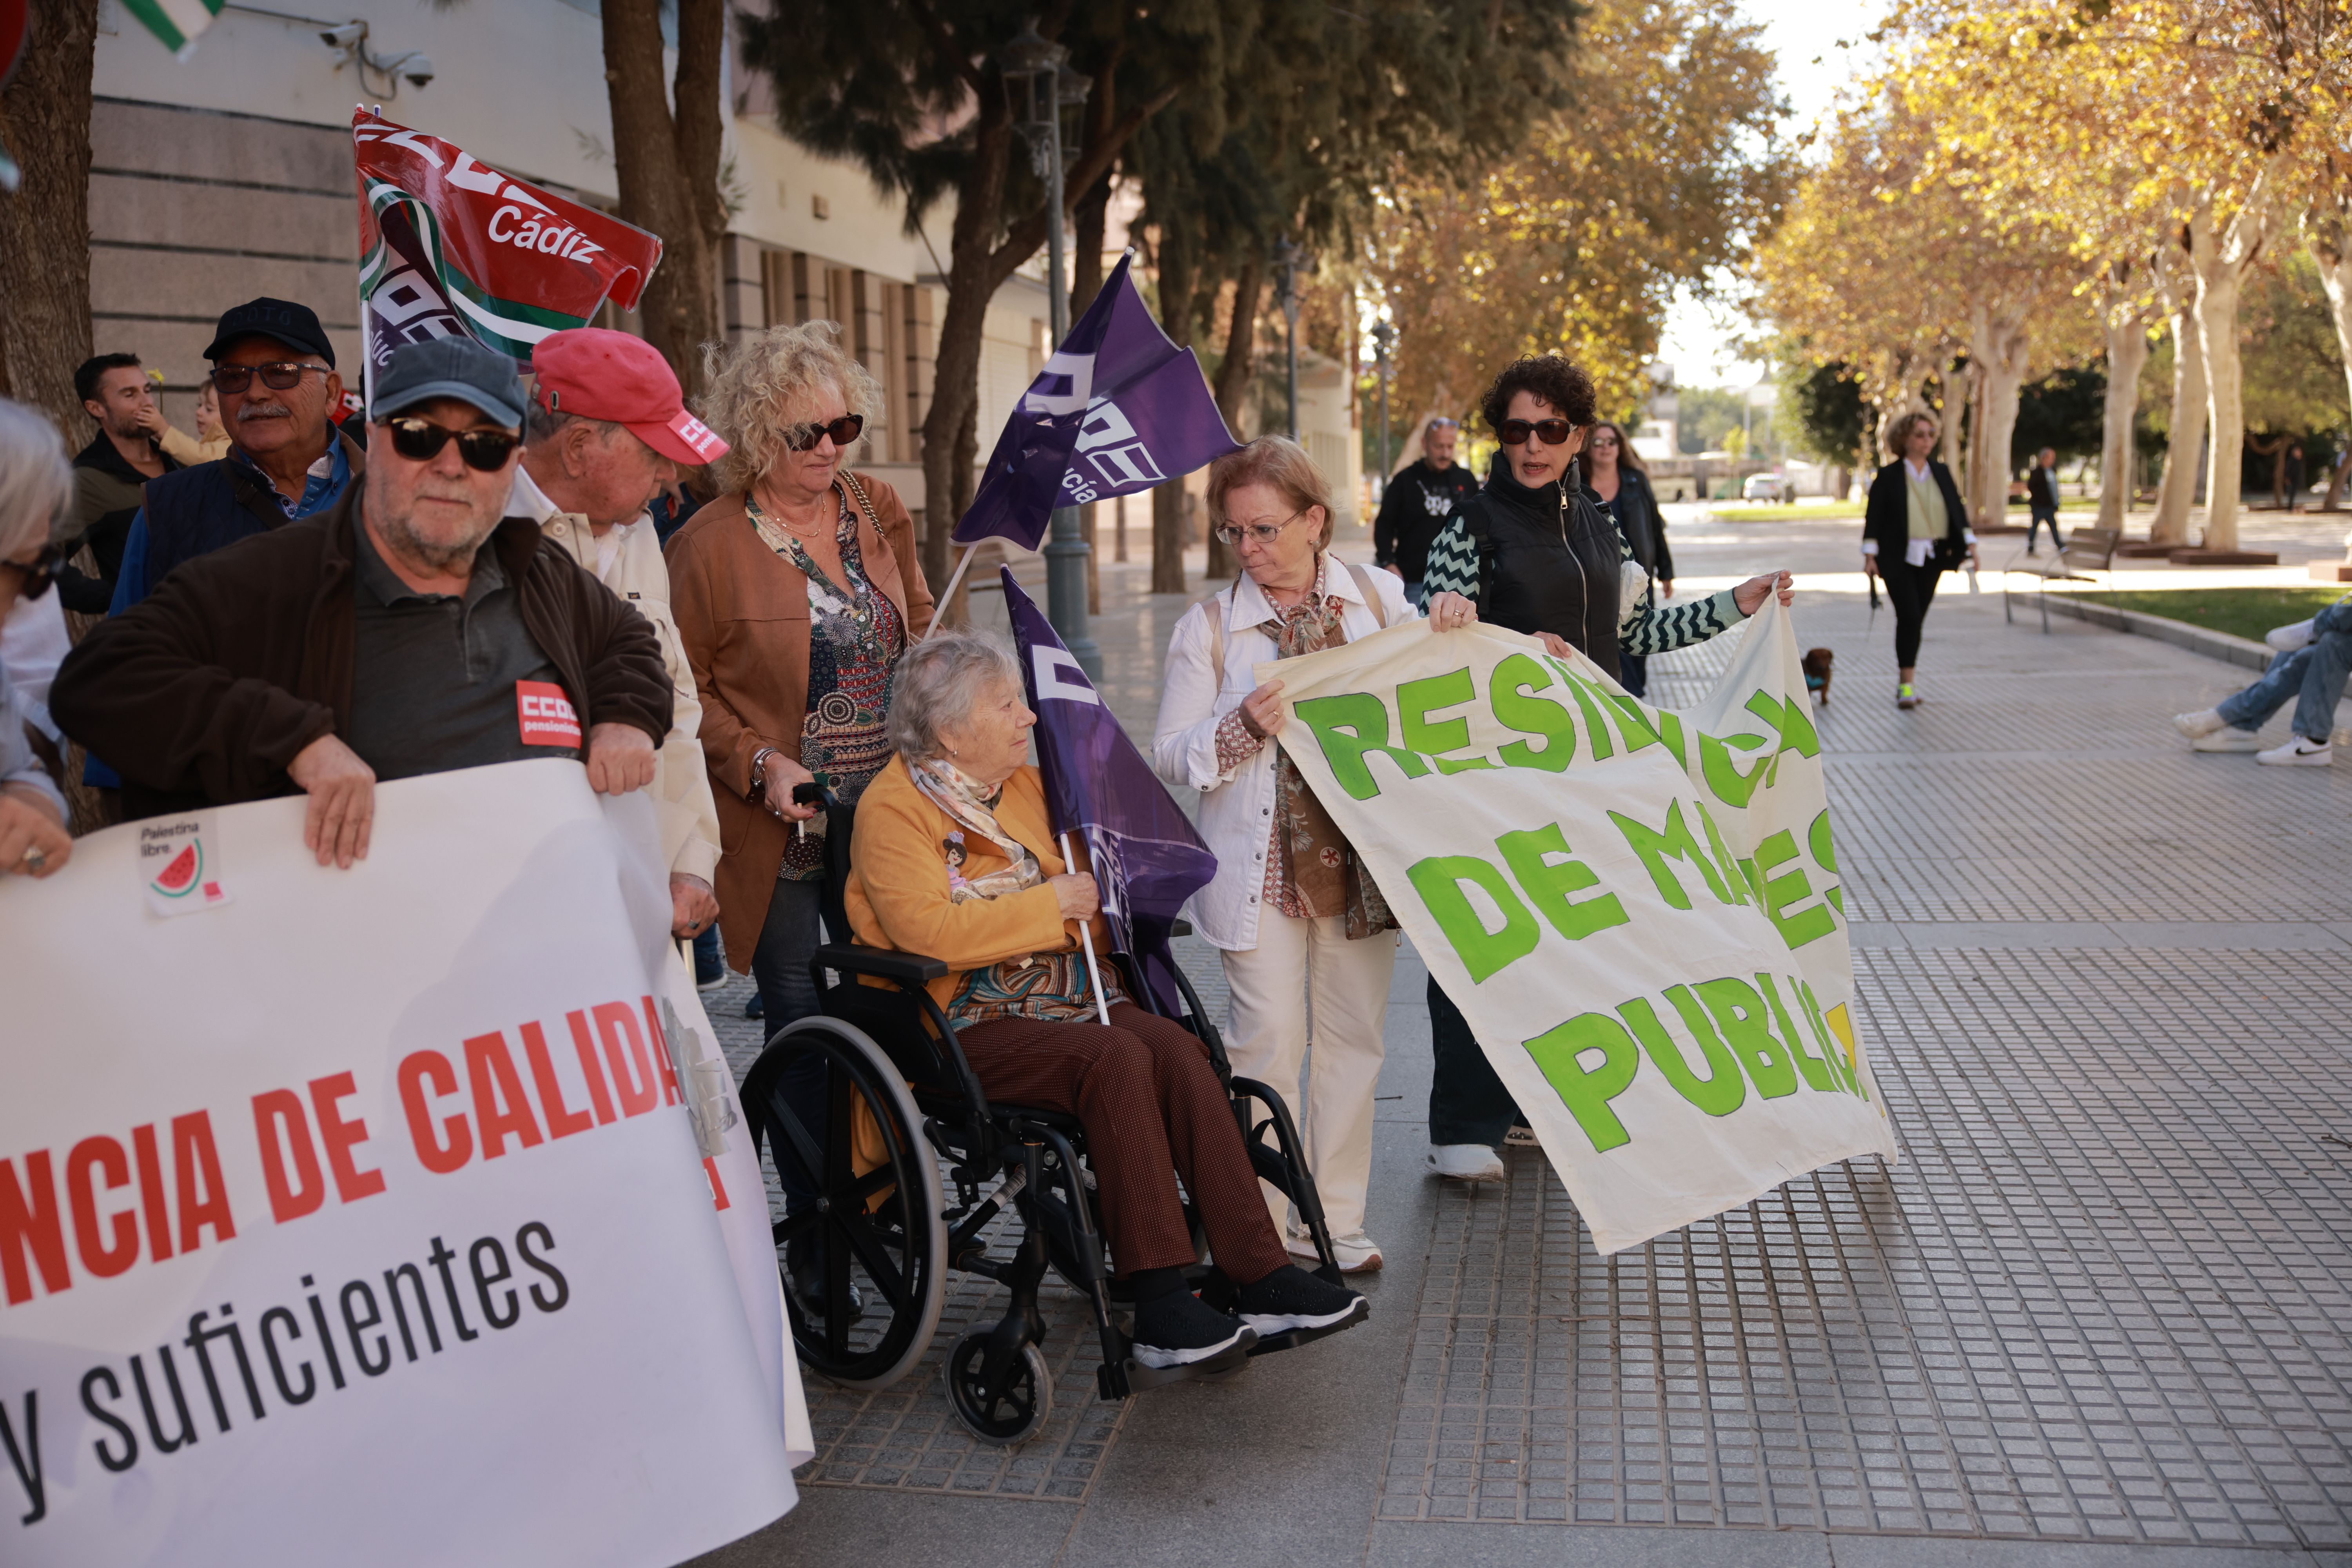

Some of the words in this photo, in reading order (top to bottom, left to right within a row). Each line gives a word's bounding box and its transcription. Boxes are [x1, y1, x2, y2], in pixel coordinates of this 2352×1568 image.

[488, 205, 606, 264] Cádiz
[141, 823, 199, 840] Palestina
[1406, 822, 1630, 985] DE
[0, 1109, 237, 1307] NCIA
[250, 1070, 387, 1225] DE
[0, 1388, 47, 1526] y
[79, 1221, 570, 1473] suficientes
